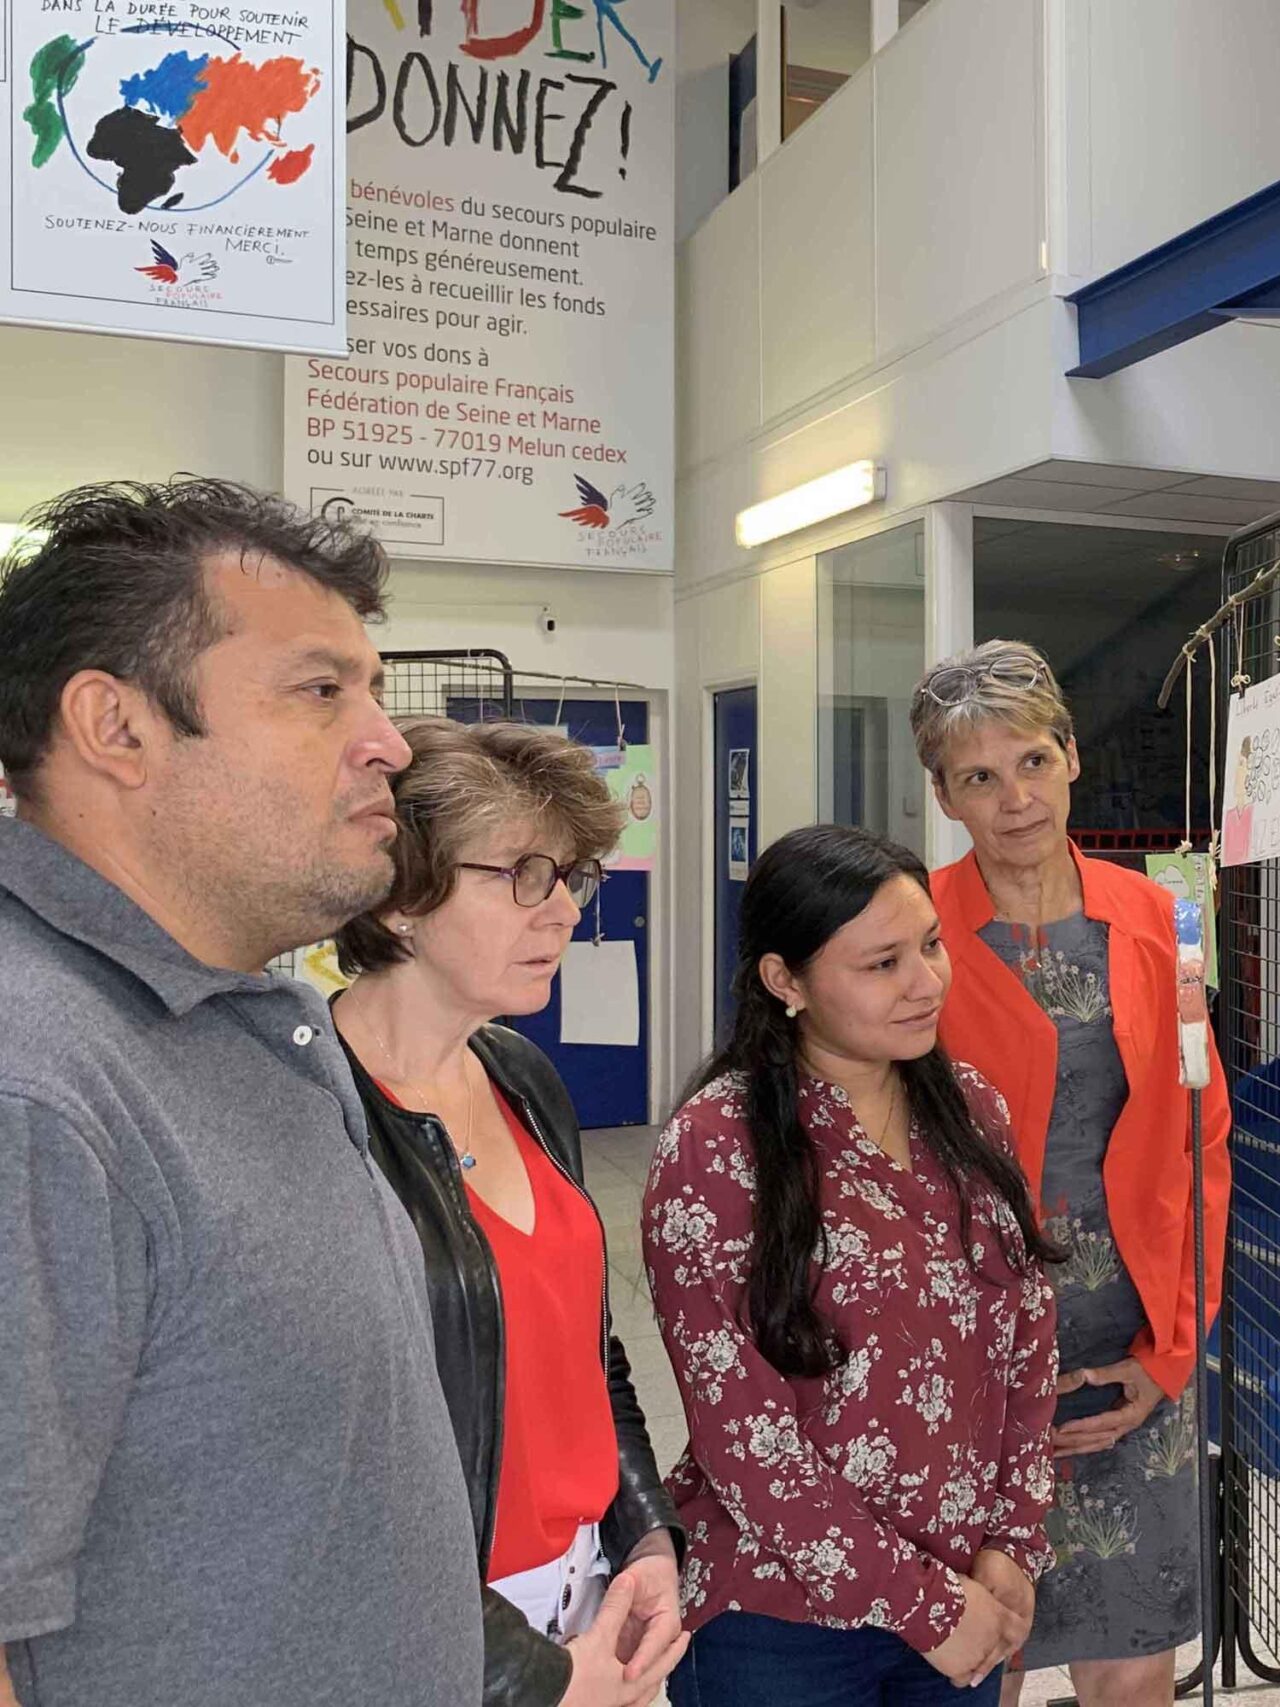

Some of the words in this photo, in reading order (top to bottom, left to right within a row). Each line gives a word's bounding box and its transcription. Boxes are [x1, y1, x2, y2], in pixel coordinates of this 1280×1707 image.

[41, 0, 82, 13] DANS
[95, 0, 115, 14] LA
[128, 0, 178, 18] DURÉE
[190, 3, 231, 22] POUR
[95, 14, 121, 35] LE
[136, 13, 302, 46] DÉVELOPPEMENT
[346, 206, 399, 231] Seine
[405, 219, 426, 237] et
[433, 220, 493, 245] Marne
[500, 229, 581, 258] donnent
[351, 178, 455, 213] bénévoles
[461, 197, 485, 217] du
[492, 202, 565, 229] secours
[571, 210, 657, 242] populaire
[355, 239, 419, 266] temps
[425, 250, 585, 286] généreusement.
[411, 274, 423, 294] à
[429, 279, 514, 305] recueillir
[520, 288, 547, 308] les
[552, 291, 606, 316] fonds
[436, 309, 480, 332] pour
[487, 313, 528, 338] agir.
[384, 341, 418, 360] vos
[424, 342, 471, 365] dons
[479, 349, 490, 367] à
[308, 358, 389, 385] Secours
[397, 371, 488, 397] populaire
[496, 378, 575, 405] Français
[308, 388, 419, 417] Fédération
[426, 401, 450, 419] de
[457, 403, 511, 426] Seine
[518, 412, 537, 428] et
[544, 411, 601, 434] Marne
[308, 417, 335, 437] BP
[343, 422, 413, 446] 51925
[433, 428, 502, 453] 77019
[508, 435, 567, 458] Melun
[572, 444, 629, 464] cedex
[308, 447, 333, 465] ou
[342, 451, 373, 468] sur
[380, 452, 533, 485] www.spf77.org
